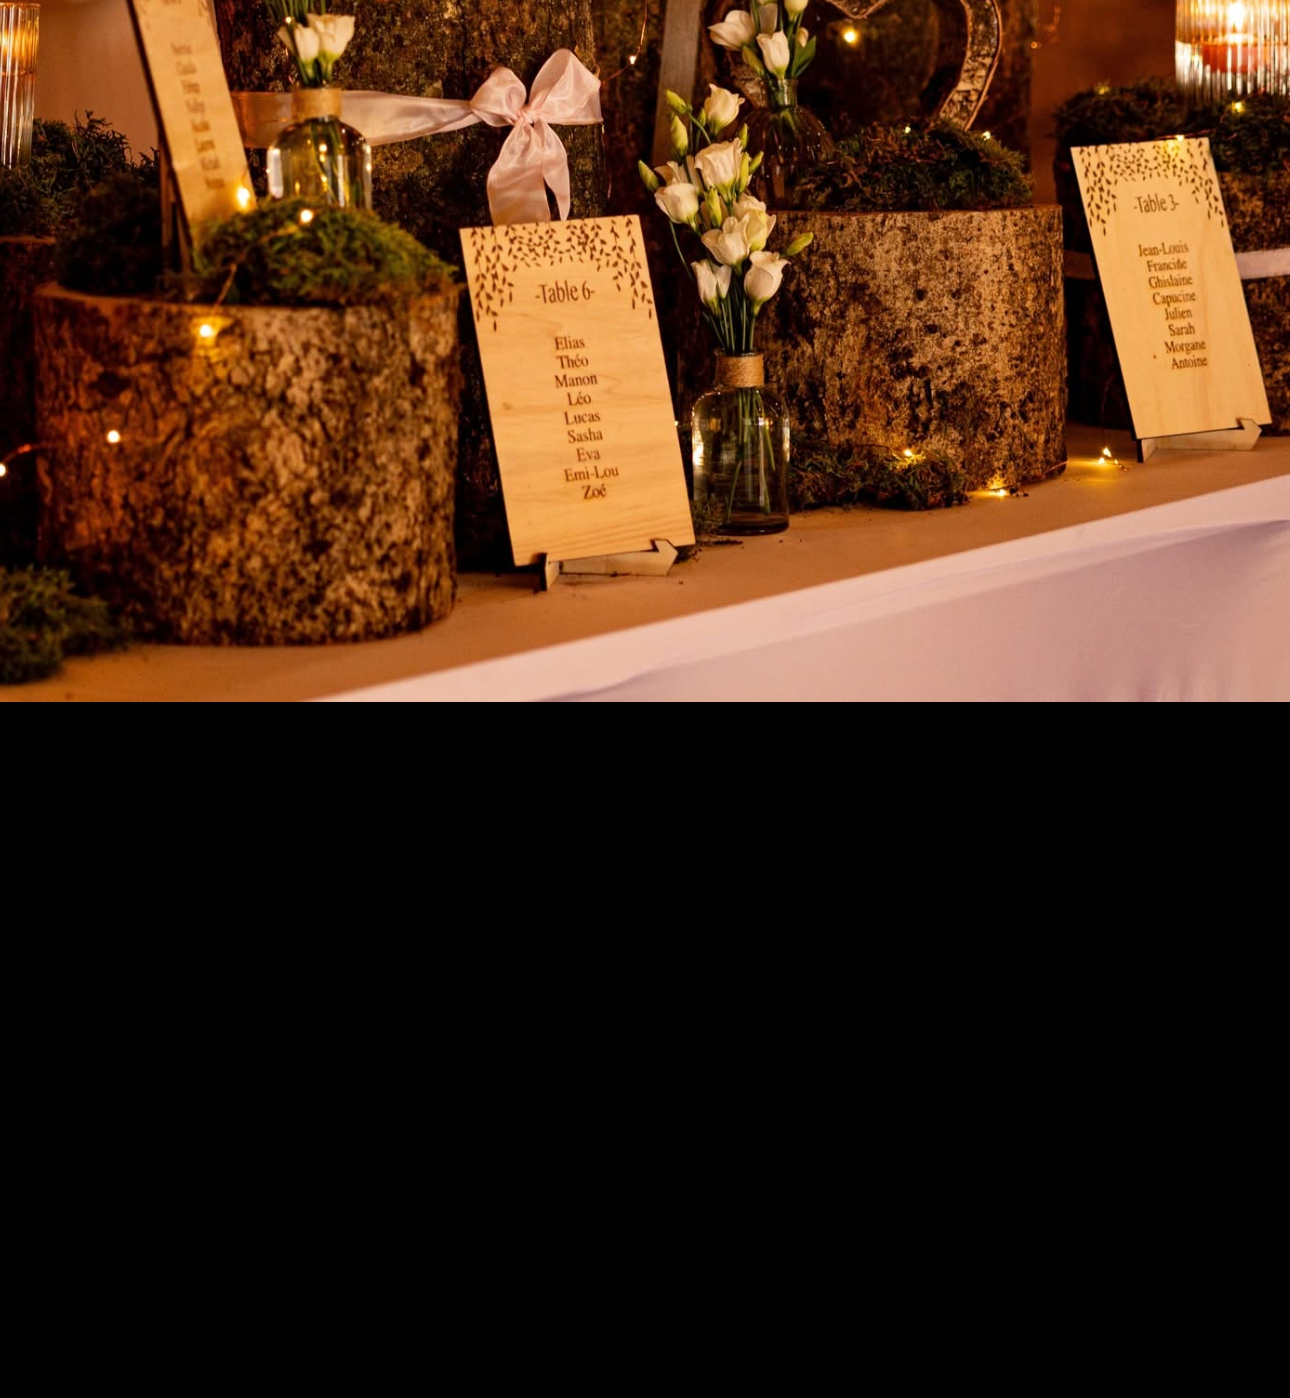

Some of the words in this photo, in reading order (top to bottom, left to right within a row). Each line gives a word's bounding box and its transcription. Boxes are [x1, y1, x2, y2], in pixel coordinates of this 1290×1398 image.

[1134, 192, 1166, 214] -Table
[1168, 193, 1179, 212] 3-
[1138, 240, 1189, 257] Jean-Louis
[1146, 258, 1187, 272] Francine
[1148, 274, 1193, 289] Ghislaine
[535, 280, 578, 304] -Table
[581, 280, 595, 301] 6-
[1152, 290, 1196, 307] Capucine
[1164, 307, 1192, 321] Julien
[1168, 323, 1195, 336] Sarah
[554, 335, 585, 351] Elias
[1164, 339, 1206, 354] Morgane
[556, 354, 589, 369] Théo
[1171, 354, 1208, 370] Antoine
[554, 372, 598, 388] Manon
[567, 392, 591, 406] Léo
[564, 411, 600, 425] Lucas
[567, 428, 603, 443] Sasha
[576, 447, 601, 462] Eva
[564, 465, 619, 482] Emi-Lou
[581, 483, 607, 500] Zoé
